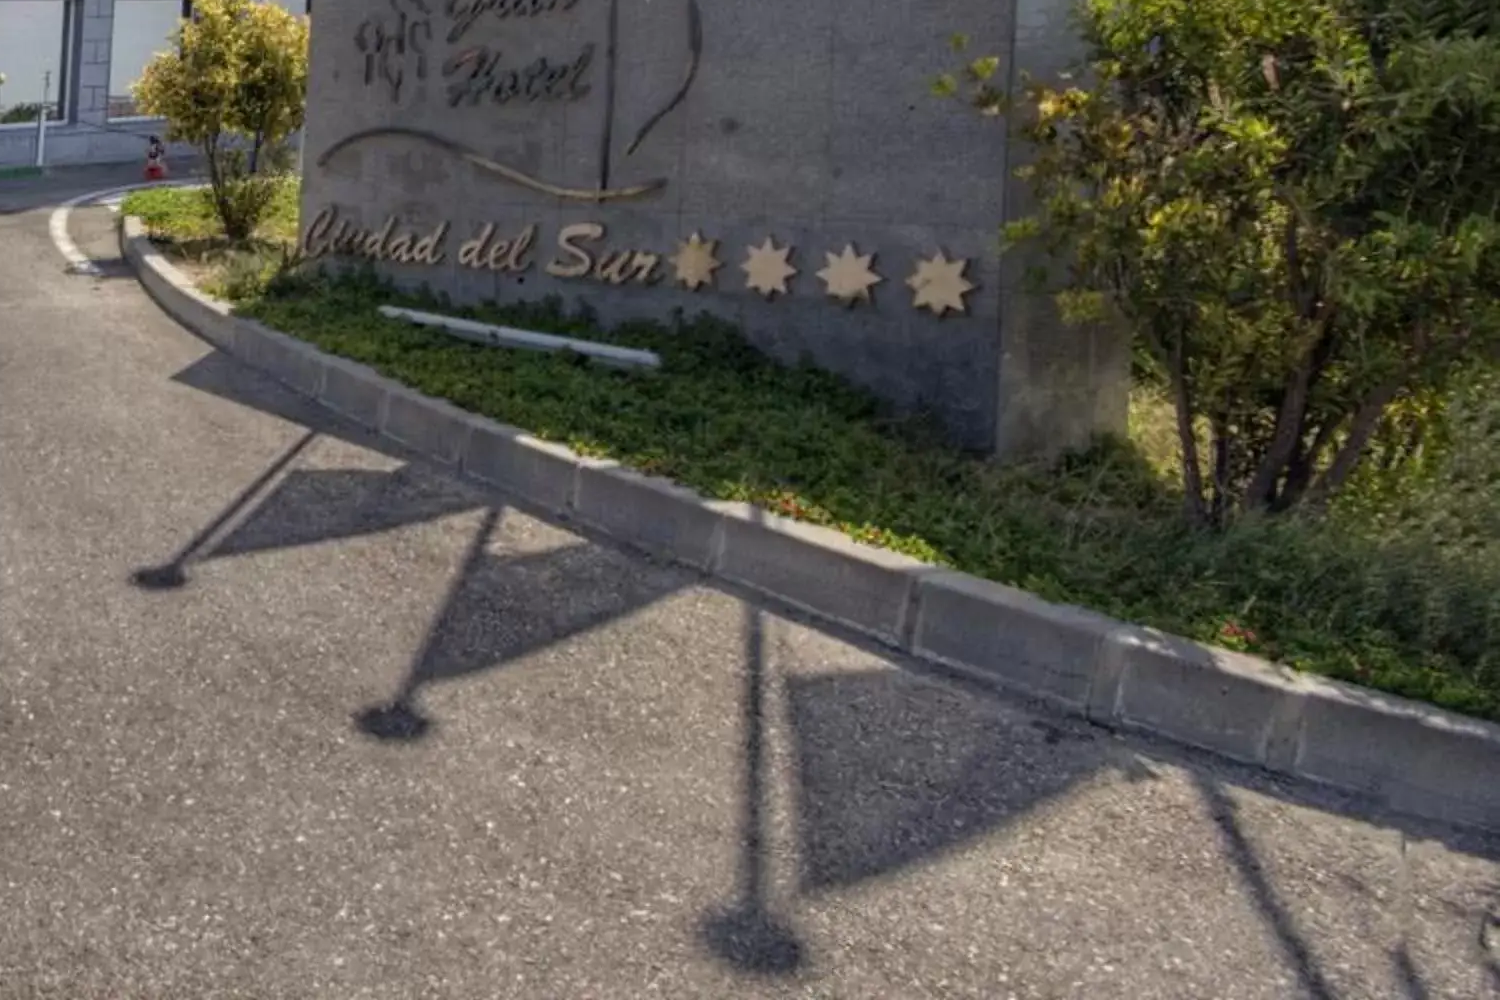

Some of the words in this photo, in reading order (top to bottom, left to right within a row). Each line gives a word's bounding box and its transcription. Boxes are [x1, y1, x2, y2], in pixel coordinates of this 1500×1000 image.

[441, 43, 596, 108] Hotel
[298, 203, 451, 266] Ciudad
[457, 220, 540, 272] del
[544, 219, 665, 285] Sur
